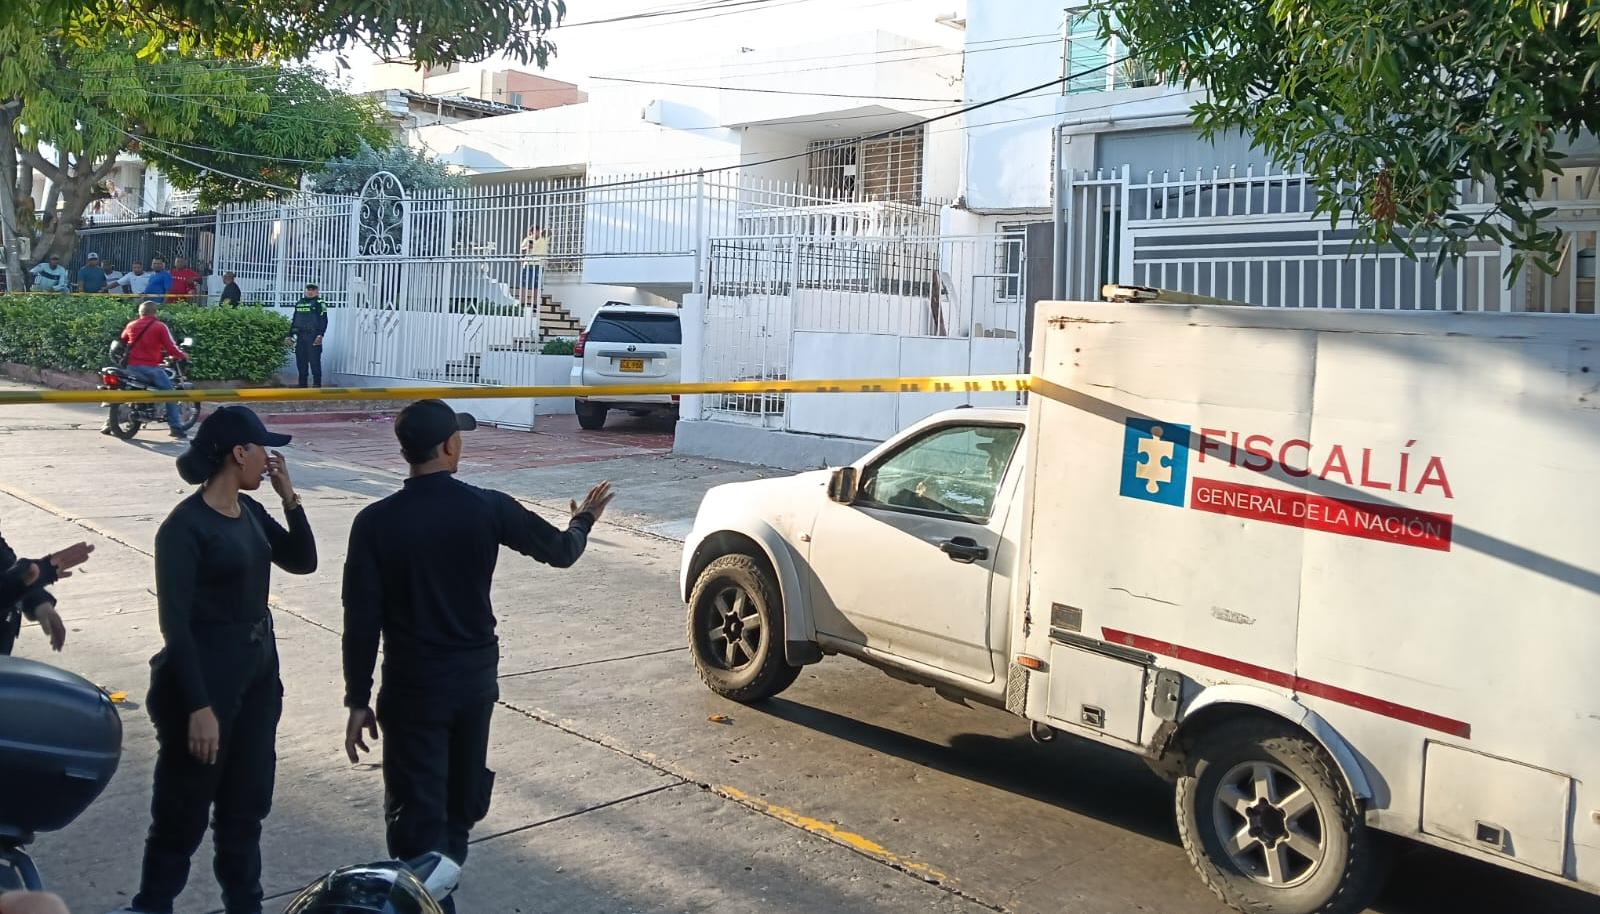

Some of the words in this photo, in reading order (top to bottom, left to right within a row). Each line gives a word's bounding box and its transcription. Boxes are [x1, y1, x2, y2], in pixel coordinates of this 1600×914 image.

[1199, 428, 1454, 499] FISCALÍA
[1197, 487, 1287, 515] GENERAL
[1292, 501, 1320, 521] DE
[1324, 506, 1349, 526] LA
[1354, 511, 1441, 540] NACIÓN
